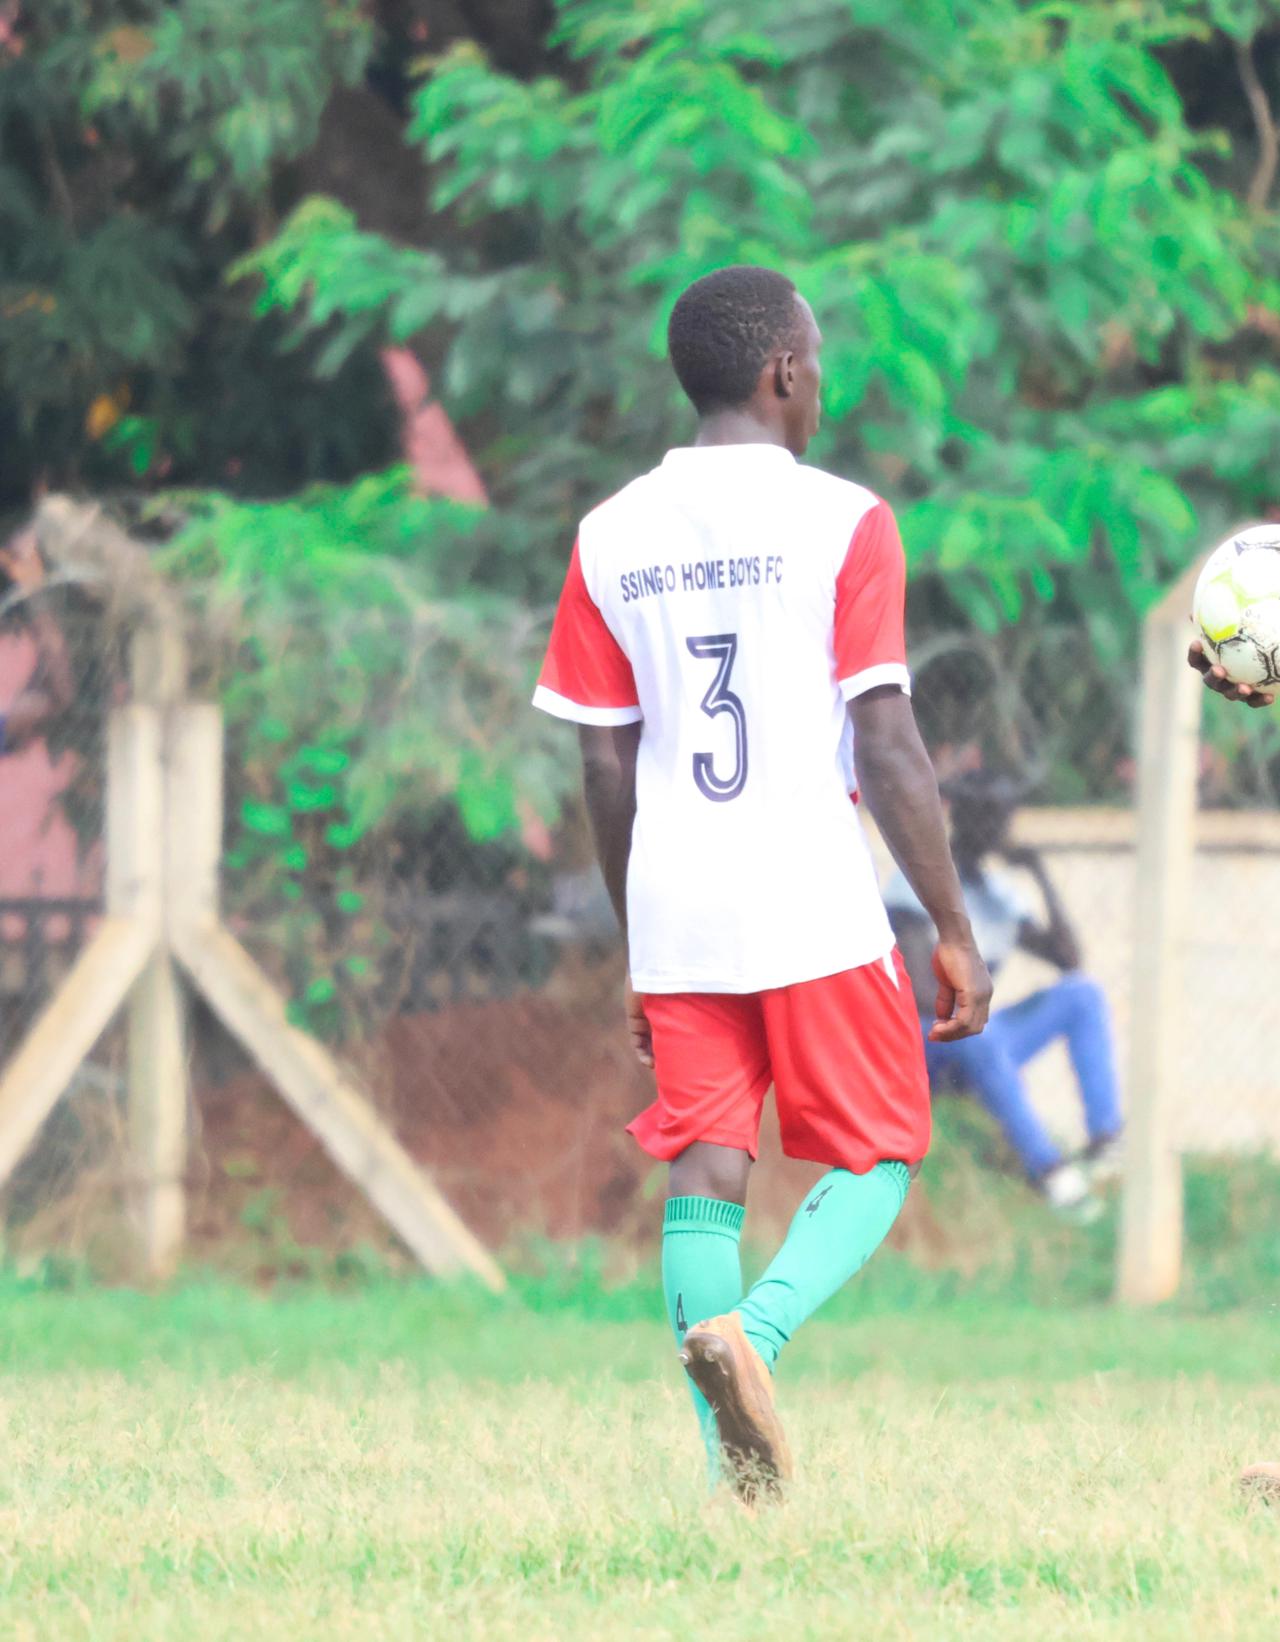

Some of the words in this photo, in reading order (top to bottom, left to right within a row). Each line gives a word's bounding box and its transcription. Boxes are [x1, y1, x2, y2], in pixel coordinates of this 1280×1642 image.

[620, 564, 676, 603] SSINGO
[681, 560, 725, 592] HOME
[729, 556, 760, 587] BOYS
[766, 555, 783, 584] FC
[686, 633, 748, 803] 3
